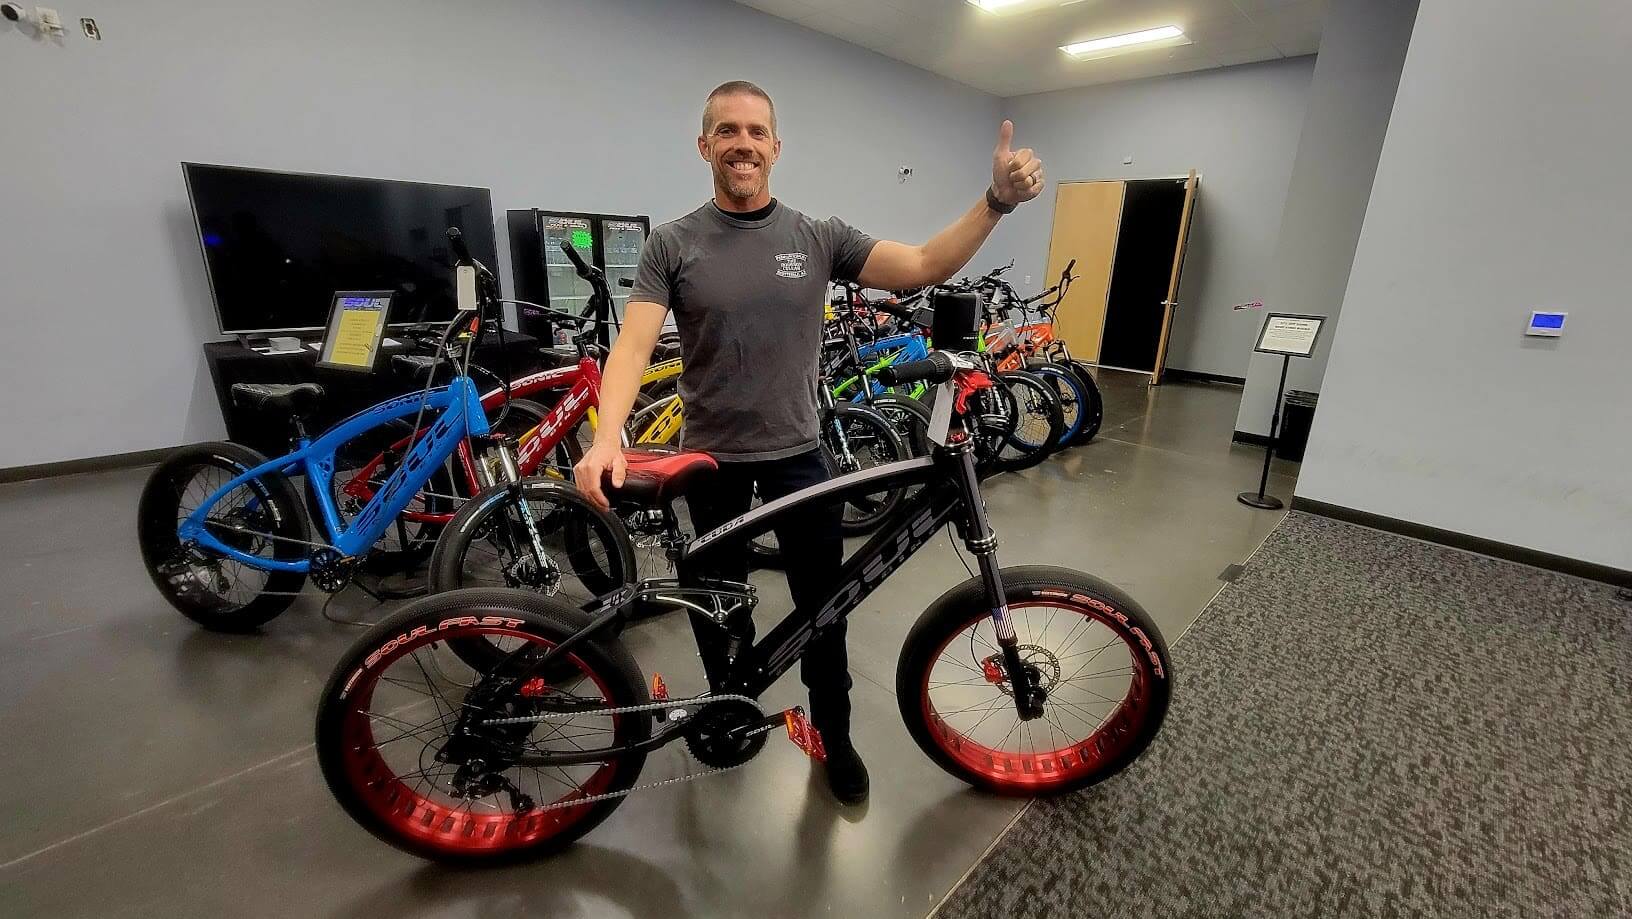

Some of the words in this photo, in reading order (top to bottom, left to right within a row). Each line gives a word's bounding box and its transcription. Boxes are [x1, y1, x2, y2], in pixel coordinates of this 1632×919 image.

[510, 371, 563, 389] SONIC
[355, 410, 463, 537] SOUL
[502, 386, 589, 480] OUL
[768, 499, 959, 675] SOUL
[365, 625, 437, 669] SOUL
[438, 616, 526, 631] FAST
[1070, 593, 1130, 629] SOUL
[1129, 626, 1164, 679] FAST
